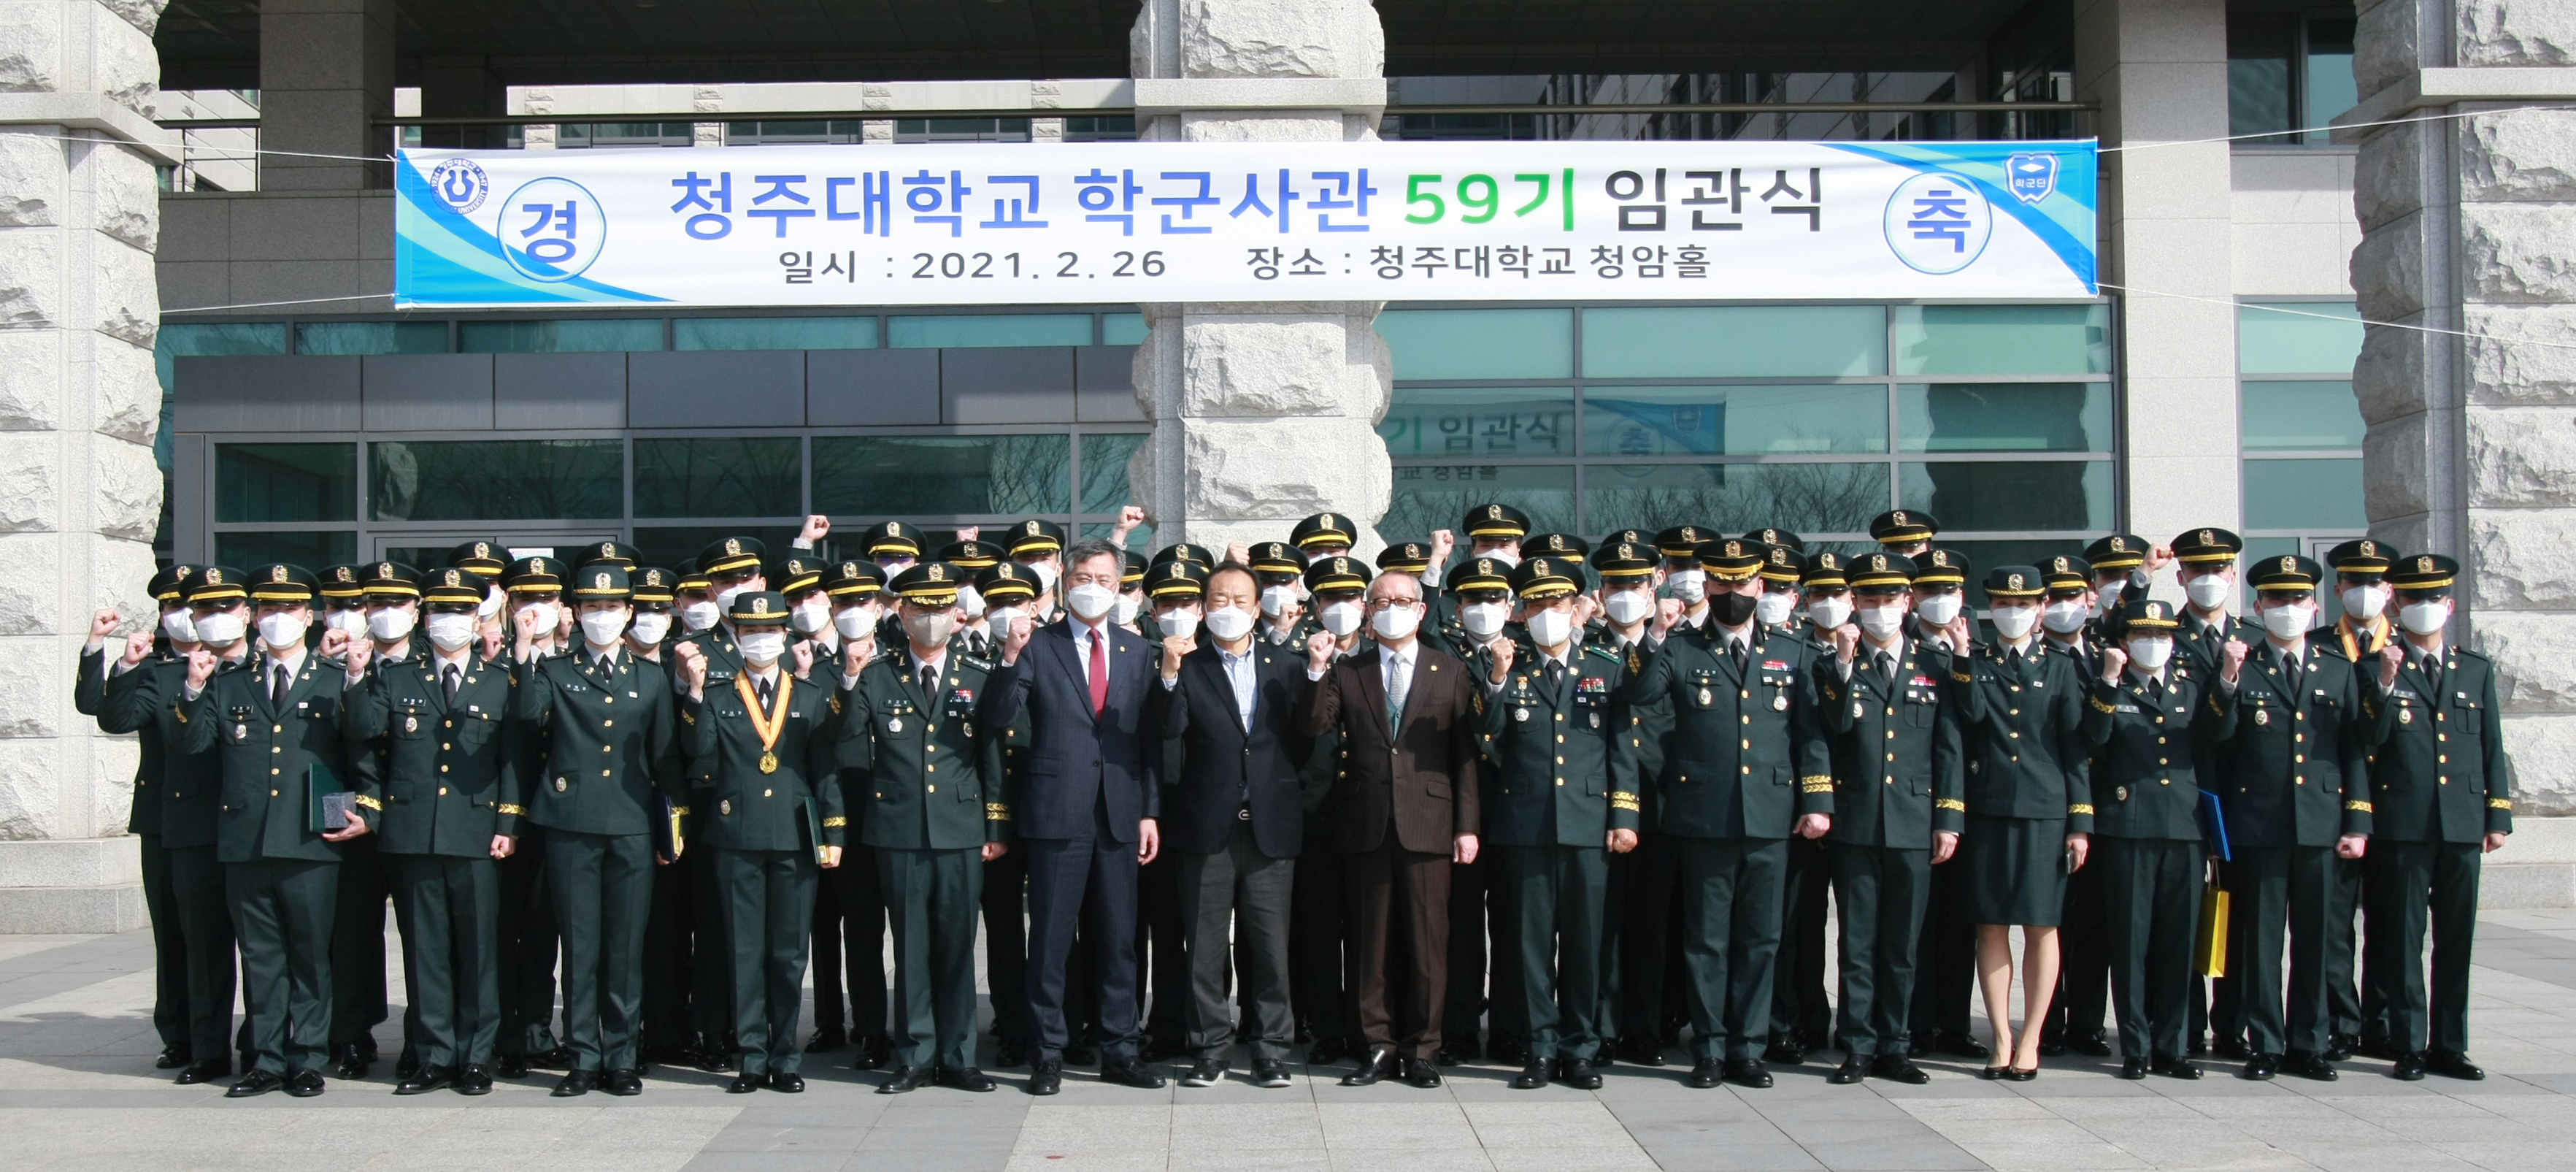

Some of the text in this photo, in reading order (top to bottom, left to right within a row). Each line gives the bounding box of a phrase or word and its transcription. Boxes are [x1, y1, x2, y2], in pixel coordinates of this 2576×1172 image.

[2015, 178, 2046, 188] 학군단
[671, 167, 1820, 241] 청주대학교 학군사관 59기 임관식
[1907, 190, 1971, 253] 축
[520, 200, 577, 264] 경
[779, 250, 855, 284] 일시
[912, 252, 1039, 280] 2021.
[1056, 251, 1096, 280] 2.
[1112, 250, 1166, 277] 26
[1246, 247, 1327, 280] 장소
[1369, 245, 1577, 279] 청주대학교
[1589, 244, 1711, 278] 청암홀
[1438, 413, 1561, 451] 임관식
